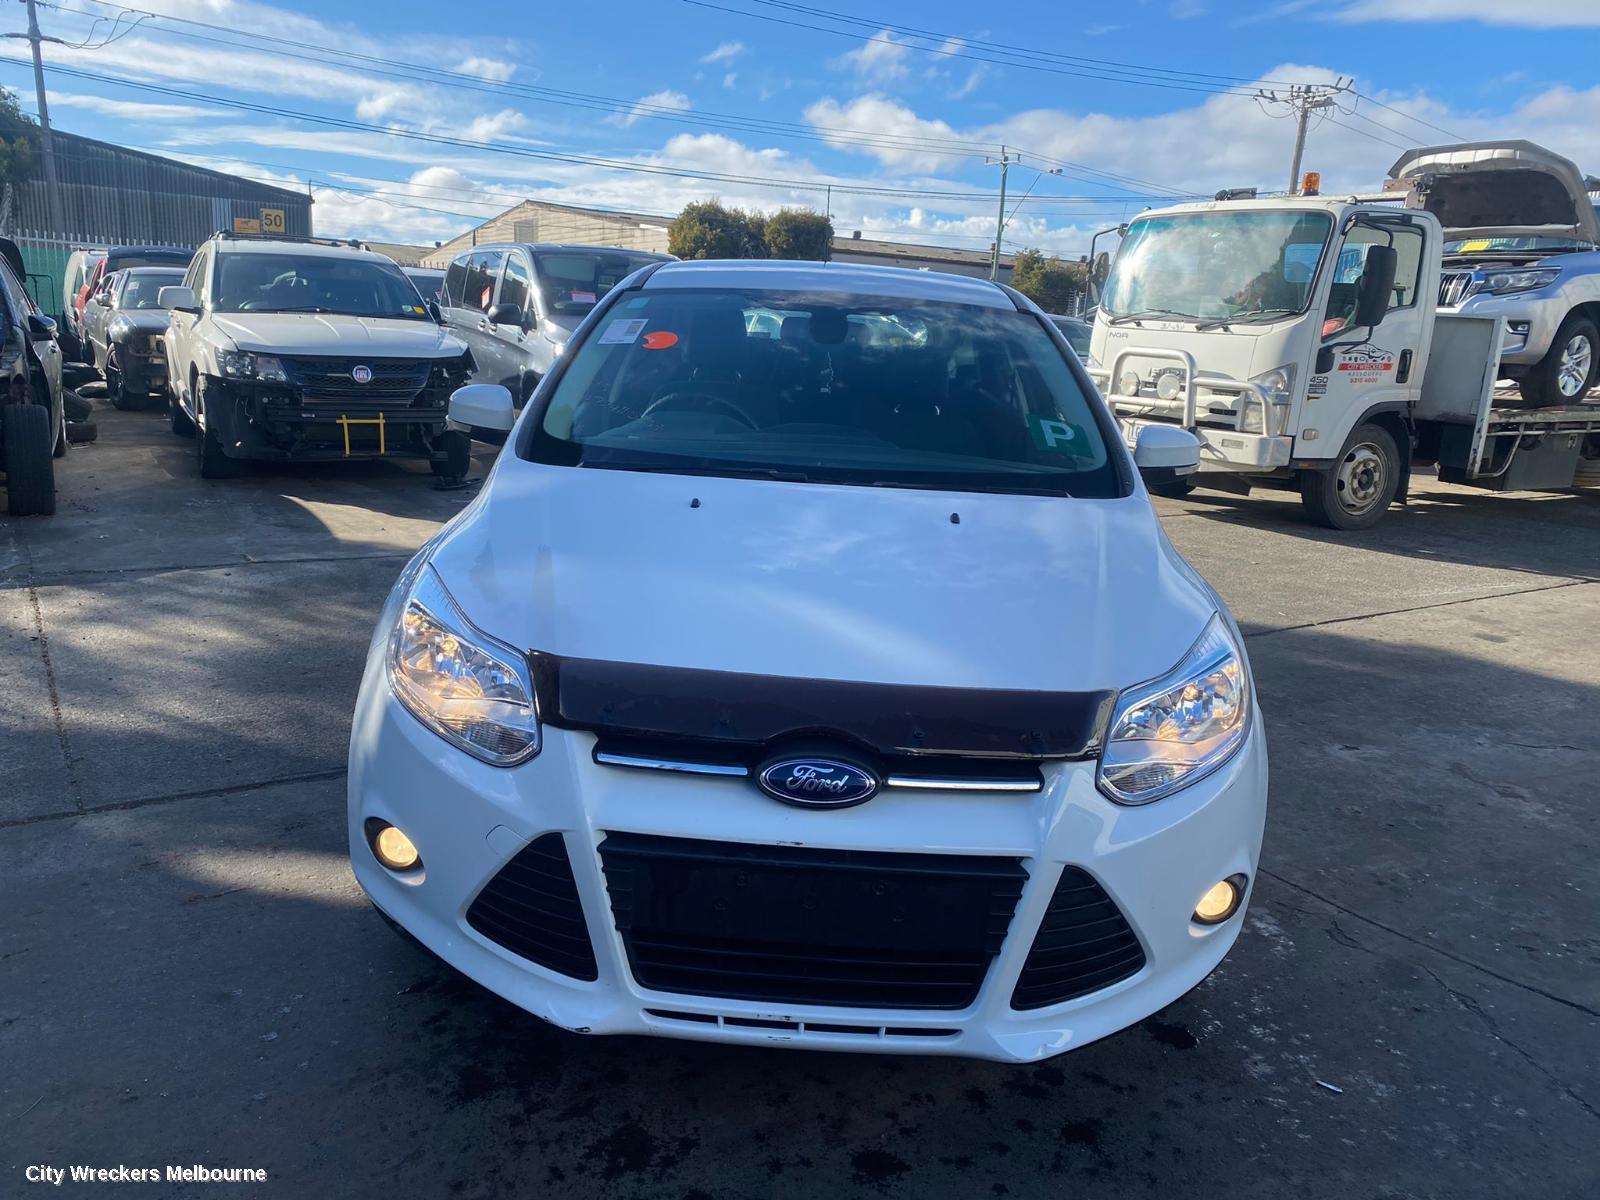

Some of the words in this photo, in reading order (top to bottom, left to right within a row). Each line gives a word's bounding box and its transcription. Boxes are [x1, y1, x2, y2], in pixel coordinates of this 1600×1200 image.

[264, 214, 282, 227] 50
[1310, 376, 1329, 384] 450
[1040, 419, 1075, 447] P
[786, 765, 849, 793] Ford
